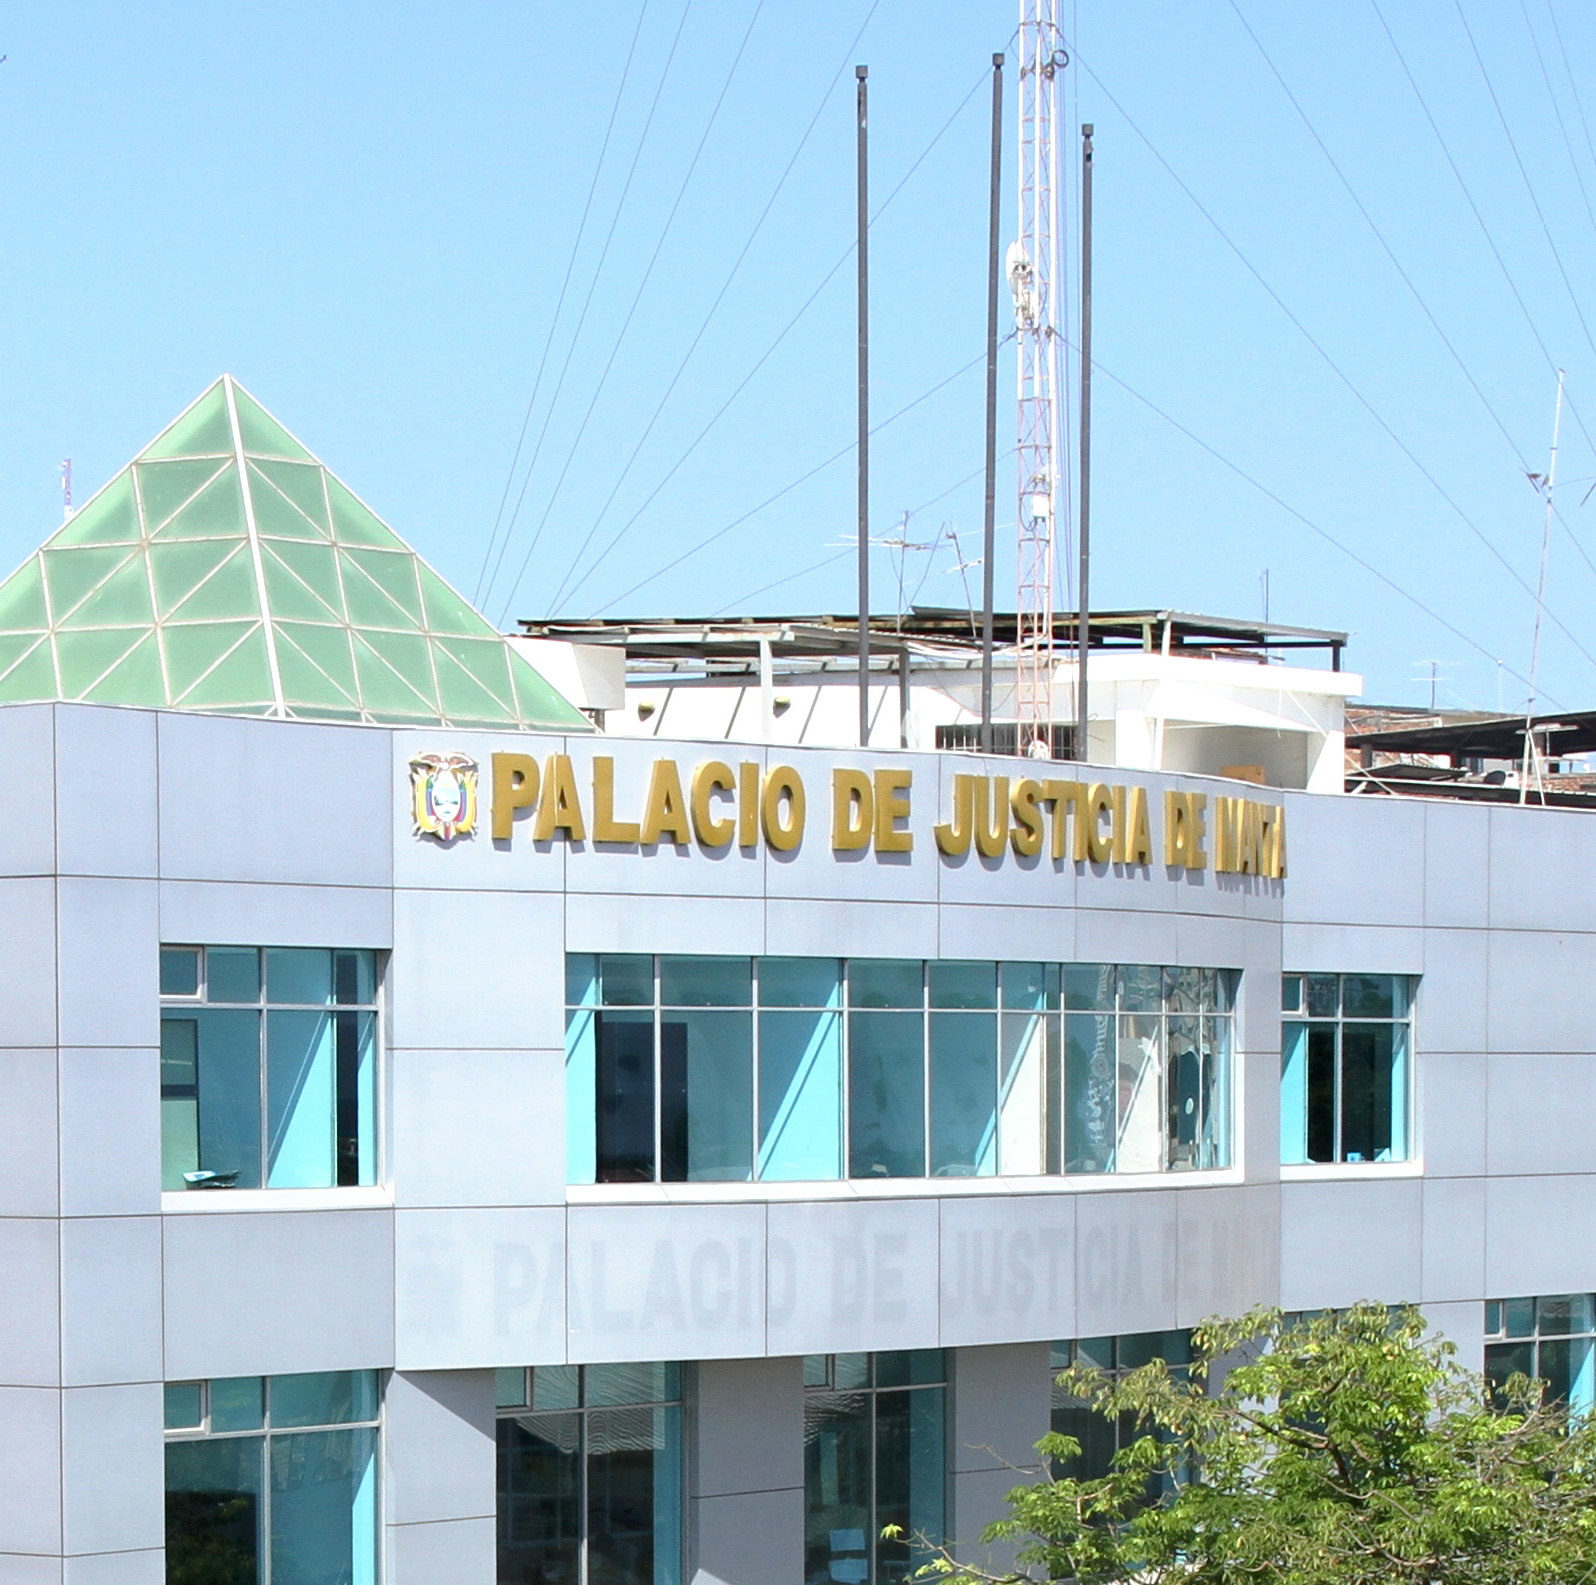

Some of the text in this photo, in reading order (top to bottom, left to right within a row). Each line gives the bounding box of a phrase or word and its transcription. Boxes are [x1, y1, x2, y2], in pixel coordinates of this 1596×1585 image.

[491, 752, 1287, 878] PALACIO DE JUSTICIA DE MANTA
